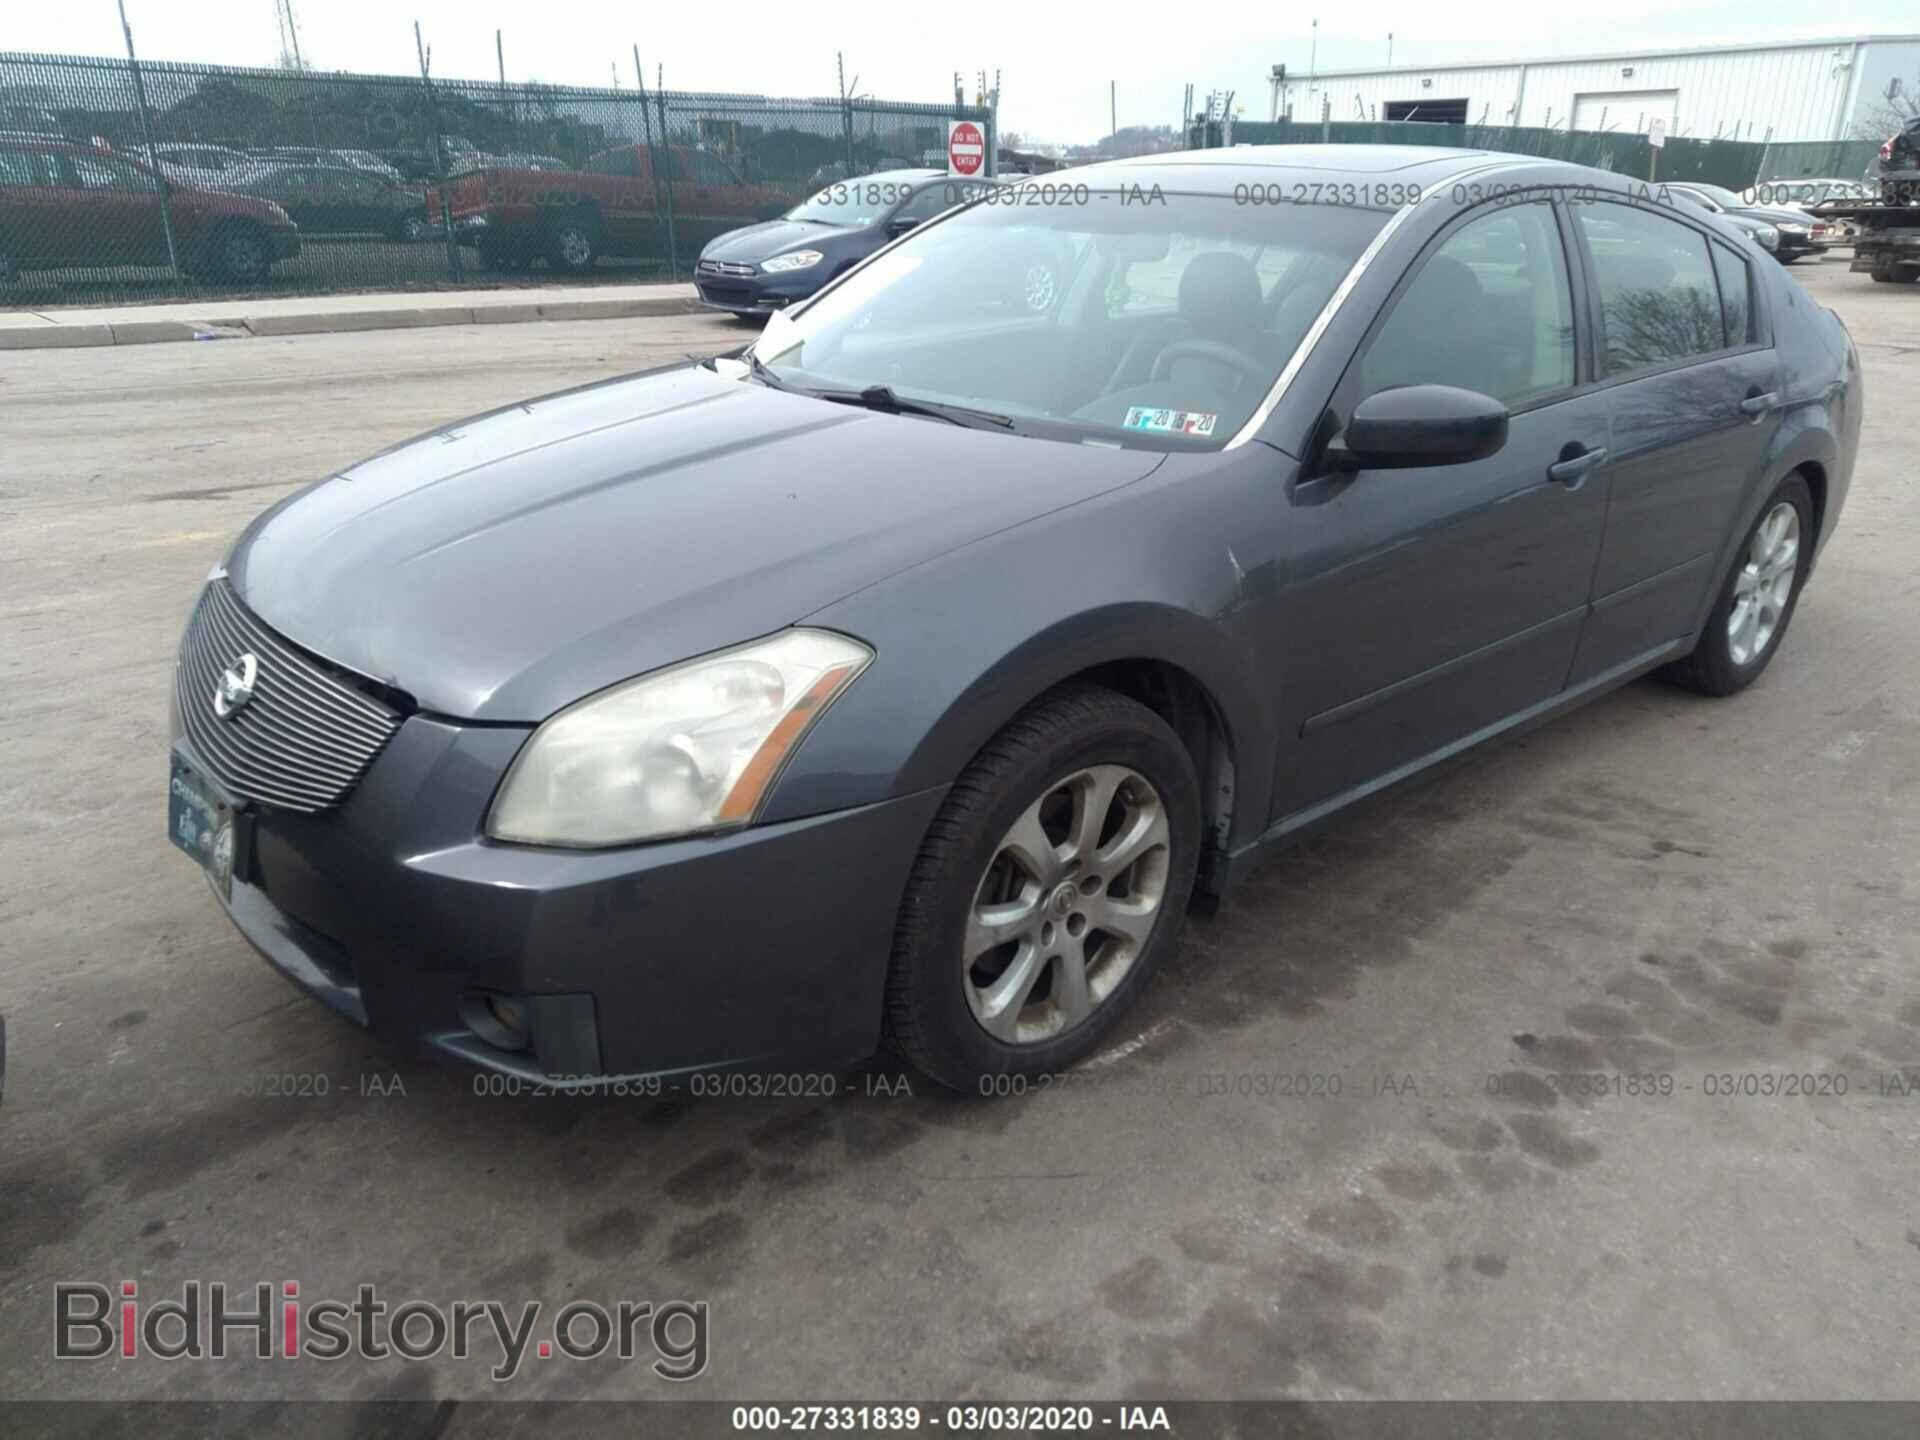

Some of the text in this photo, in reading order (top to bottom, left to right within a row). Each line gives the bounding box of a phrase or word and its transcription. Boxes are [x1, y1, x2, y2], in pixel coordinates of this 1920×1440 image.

[954, 132, 980, 143] DO NOT
[957, 156, 977, 166] ENTER
[1198, 415, 1213, 431] 20
